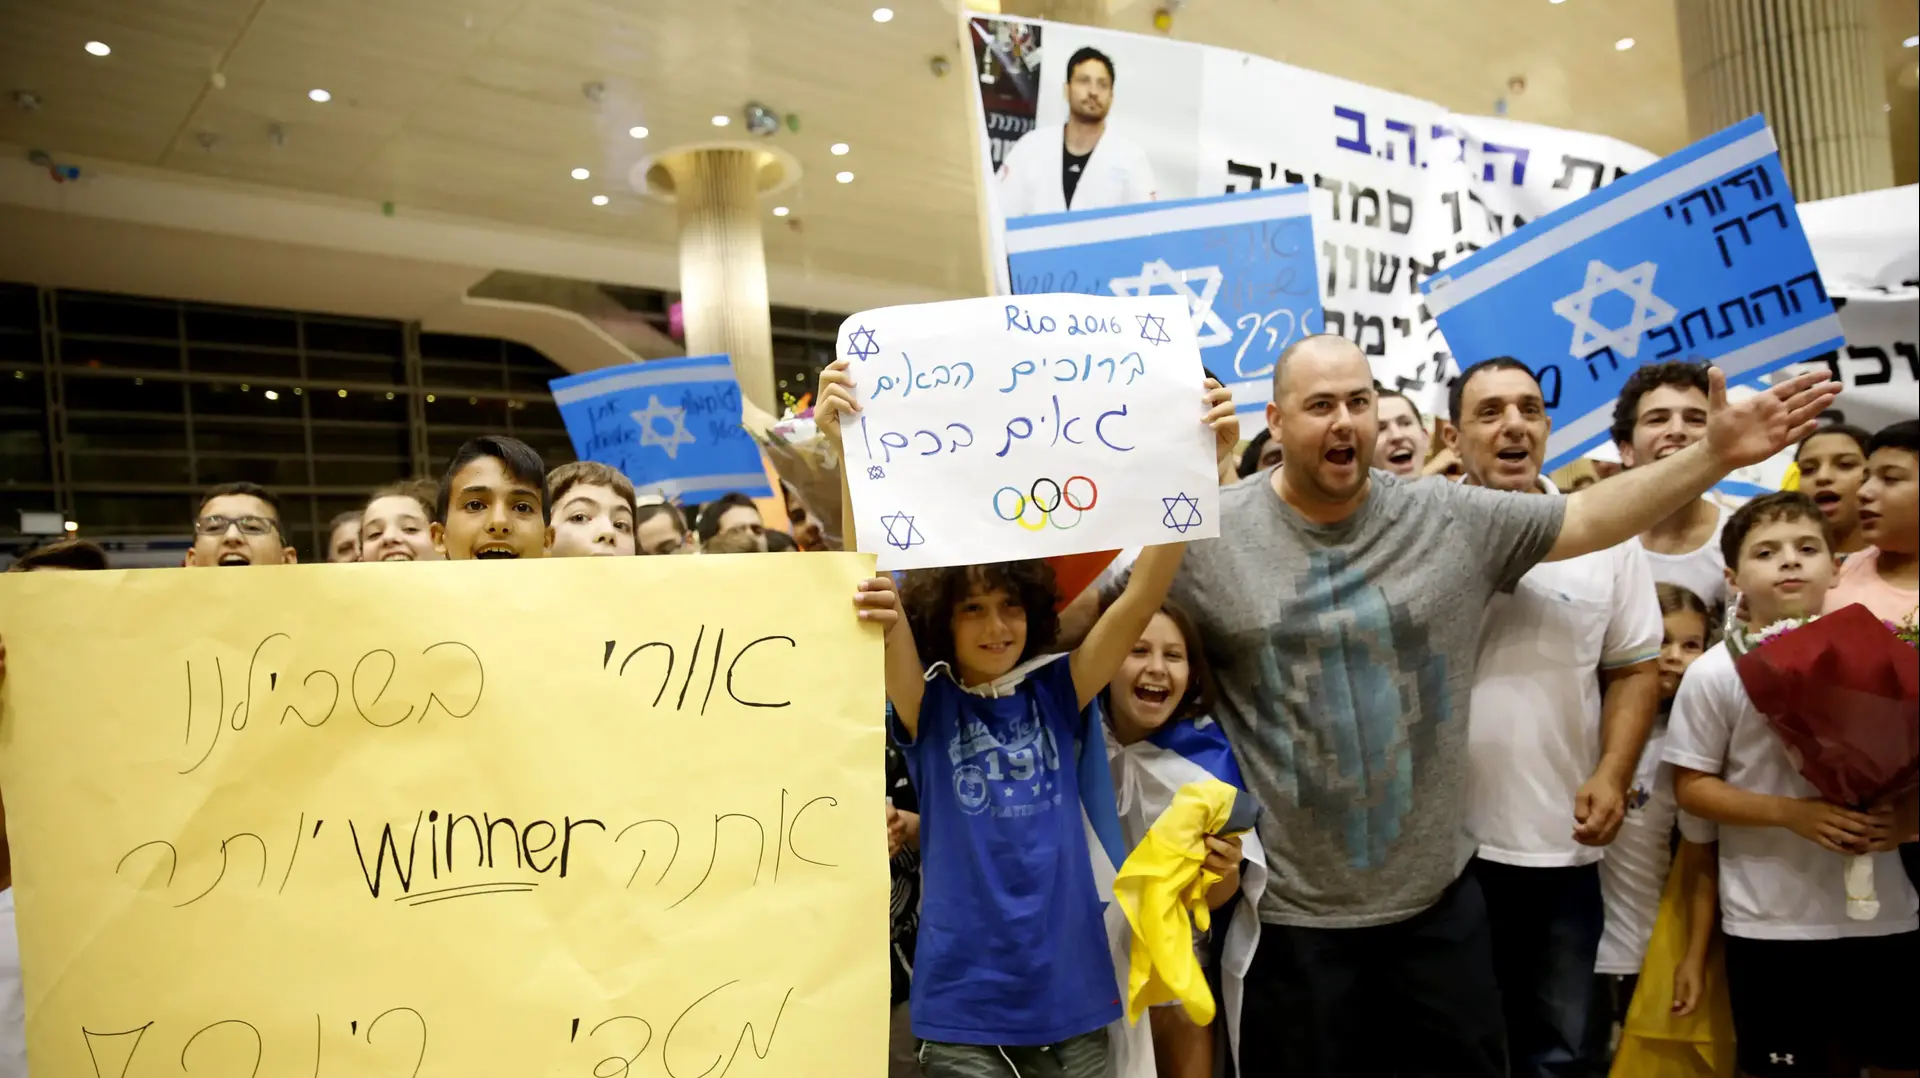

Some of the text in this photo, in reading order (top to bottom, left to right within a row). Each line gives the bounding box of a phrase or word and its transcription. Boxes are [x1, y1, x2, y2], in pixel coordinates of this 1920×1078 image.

[1712, 202, 1788, 268] רק
[1005, 305, 1122, 336] Rio 2016
[871, 351, 1145, 400] ברוכים הבאים
[860, 394, 1136, 463] גאים בכם!
[178, 624, 797, 775] אורי בשבילנו
[115, 812, 324, 908] יותר
[614, 788, 842, 911] אתה
